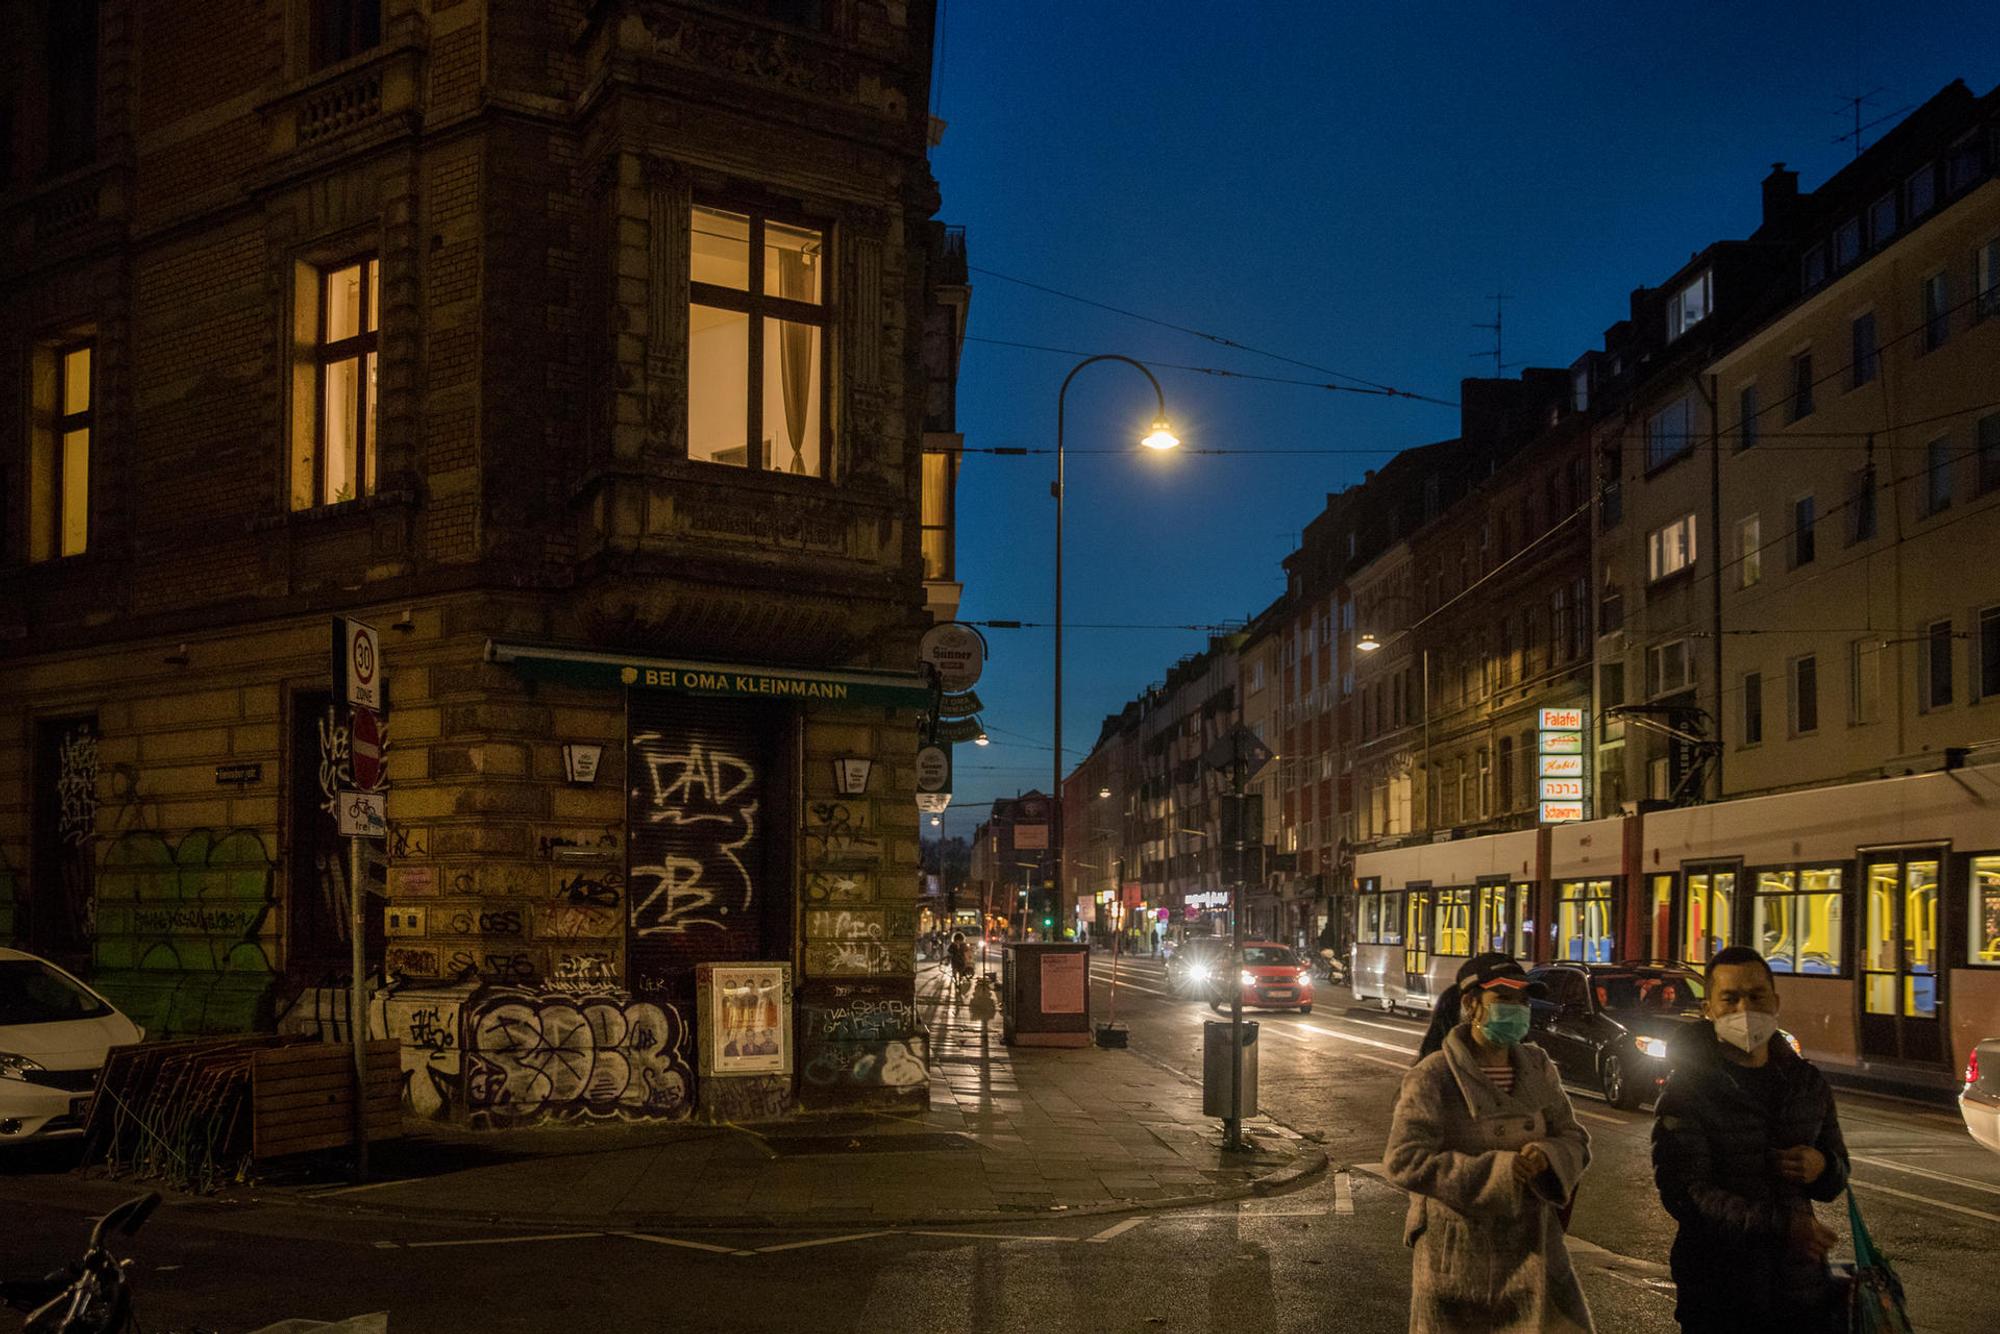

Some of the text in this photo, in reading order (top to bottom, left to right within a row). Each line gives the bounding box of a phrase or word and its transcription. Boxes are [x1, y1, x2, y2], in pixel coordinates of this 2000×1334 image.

[357, 643, 371, 670] 30
[645, 669, 848, 698] BEI OMA KLEINMANN
[356, 686, 373, 704] ZONE
[1544, 711, 1580, 727] Falafel
